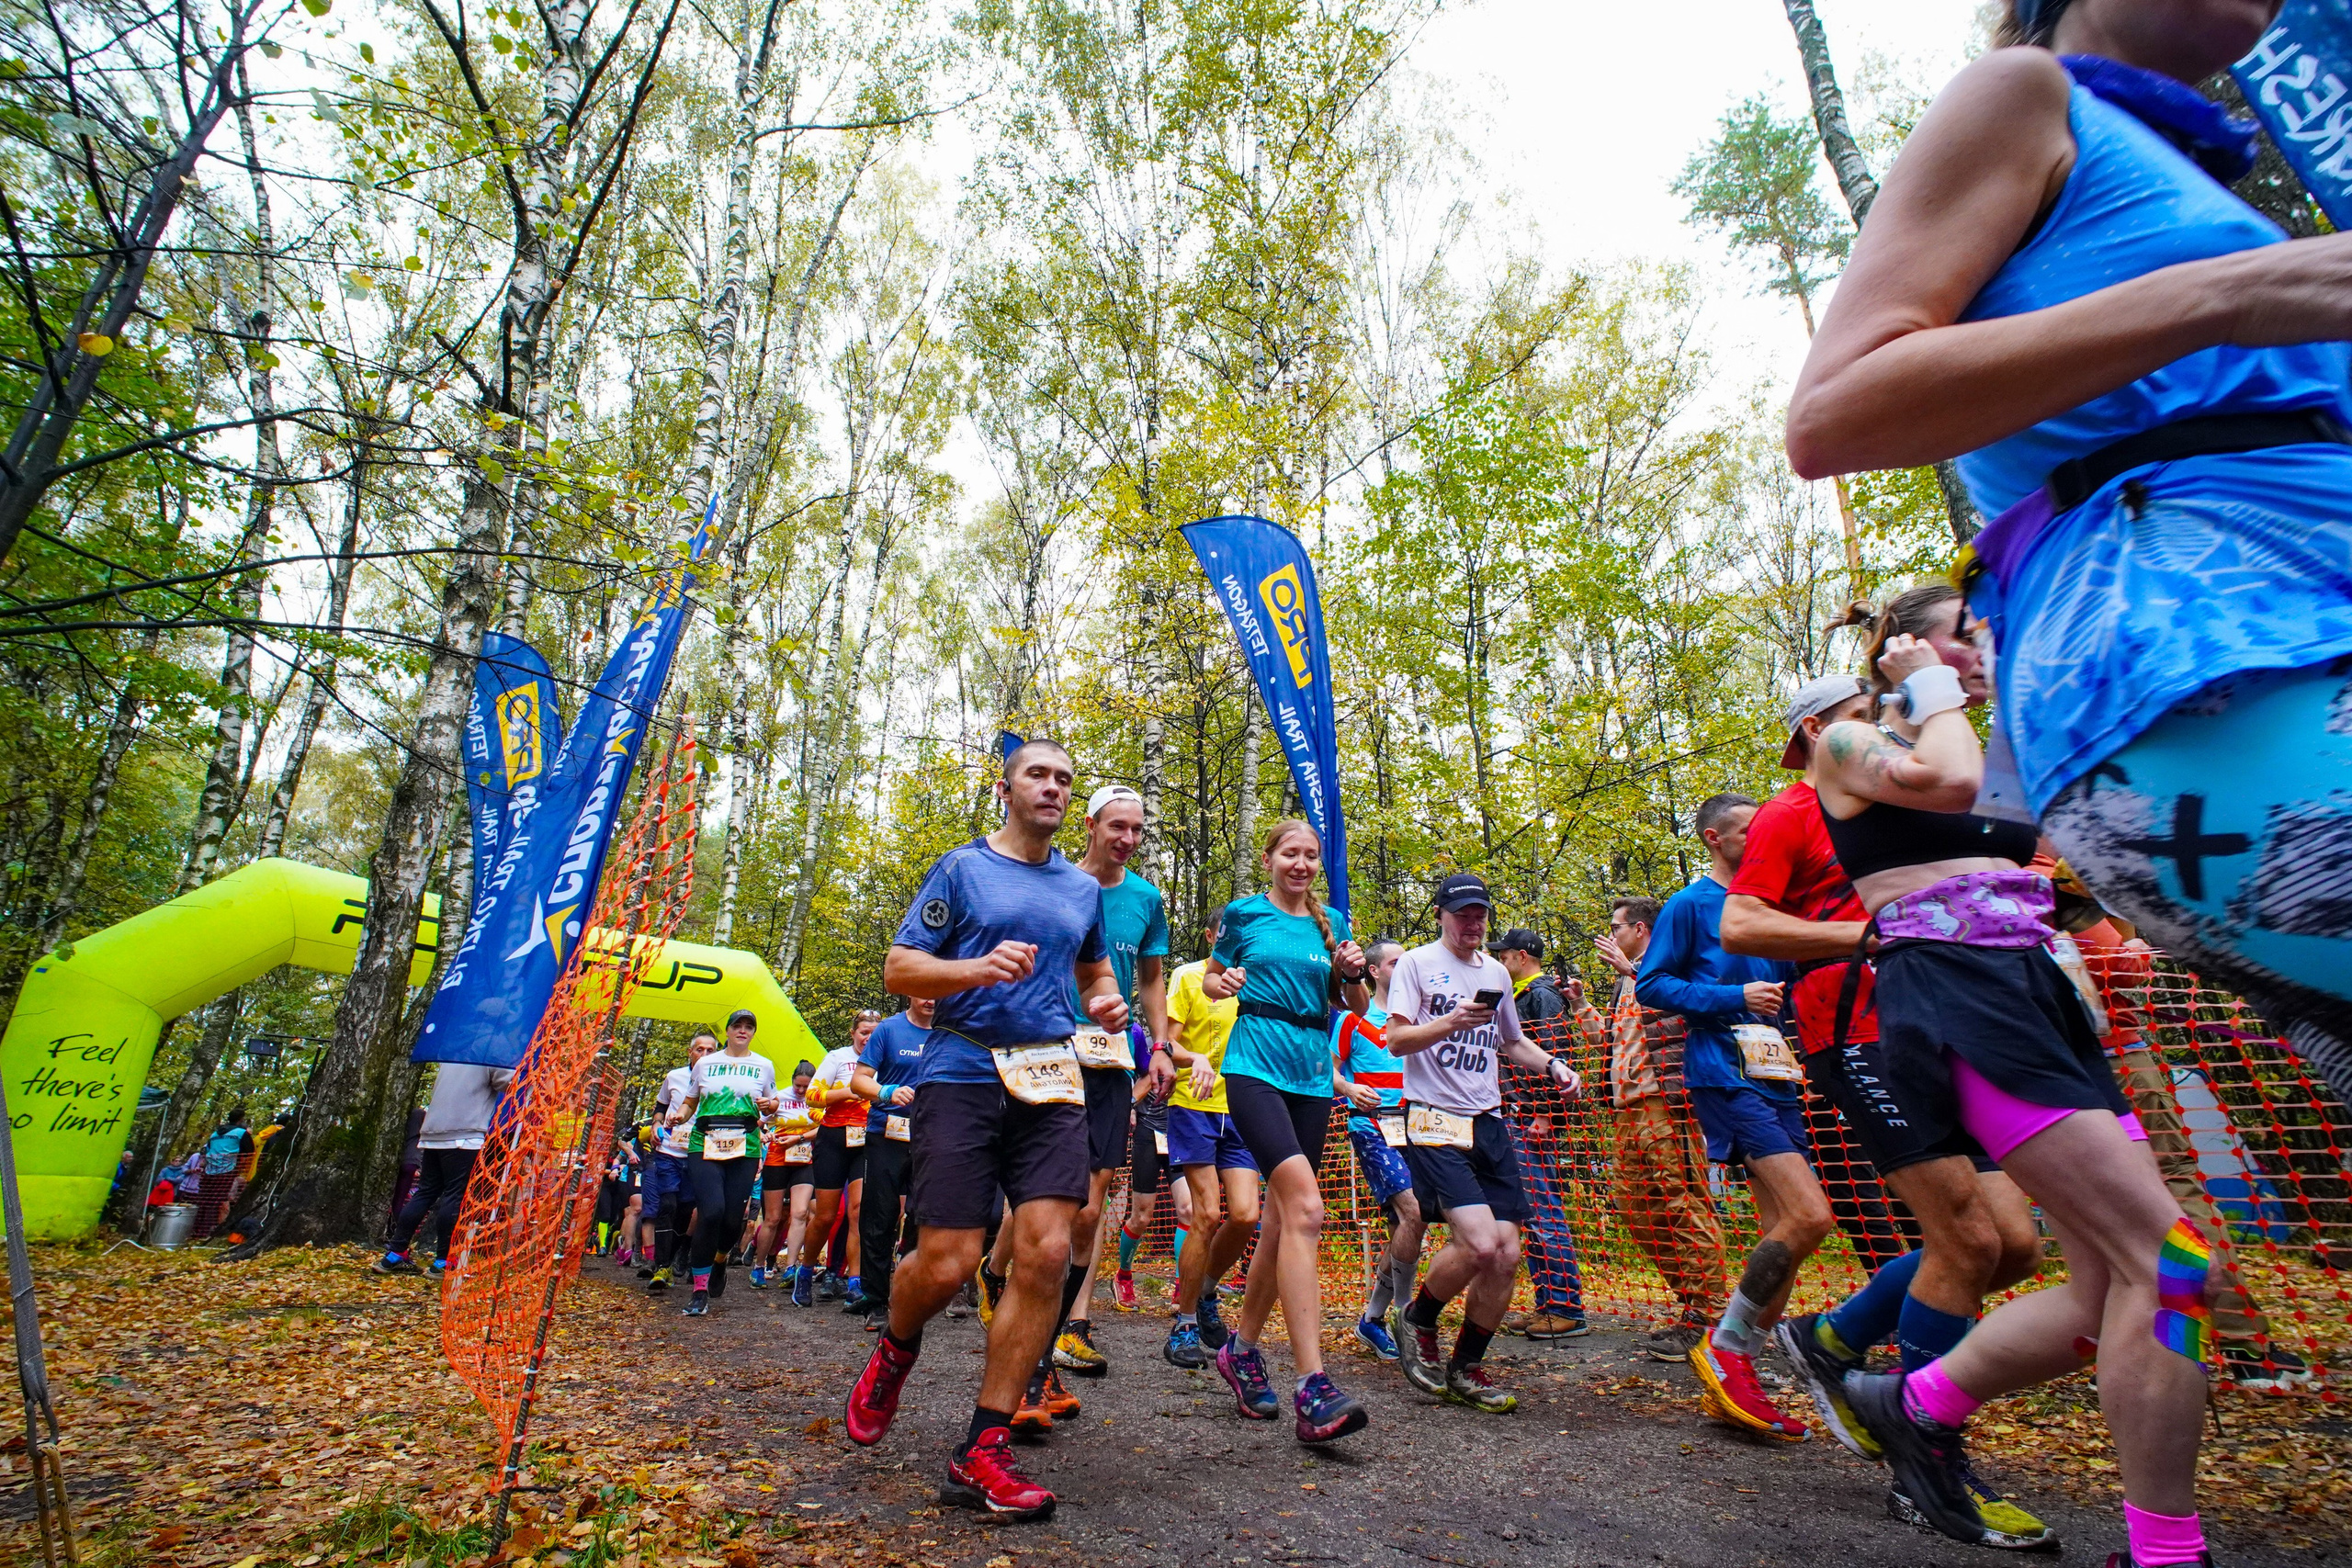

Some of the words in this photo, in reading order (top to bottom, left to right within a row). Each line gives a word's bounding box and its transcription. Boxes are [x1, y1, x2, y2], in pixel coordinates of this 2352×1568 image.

[48, 1033, 129, 1066] Feel
[1090, 1036, 1107, 1050] 99
[1764, 1043, 1779, 1056] 27
[899, 1049, 920, 1057] СУТКИ
[1436, 1043, 1488, 1074] Club
[707, 1064, 762, 1079] IZMYLONG
[1026, 1063, 1064, 1080] 148
[20, 1067, 124, 1101] there's
[1842, 1043, 1909, 1127] ALANCE
[8, 1112, 33, 1130] o
[49, 1102, 123, 1136] limit
[1434, 1113, 1443, 1125] 5
[1418, 1125, 1459, 1138] Александр
[717, 1140, 734, 1148] 119
